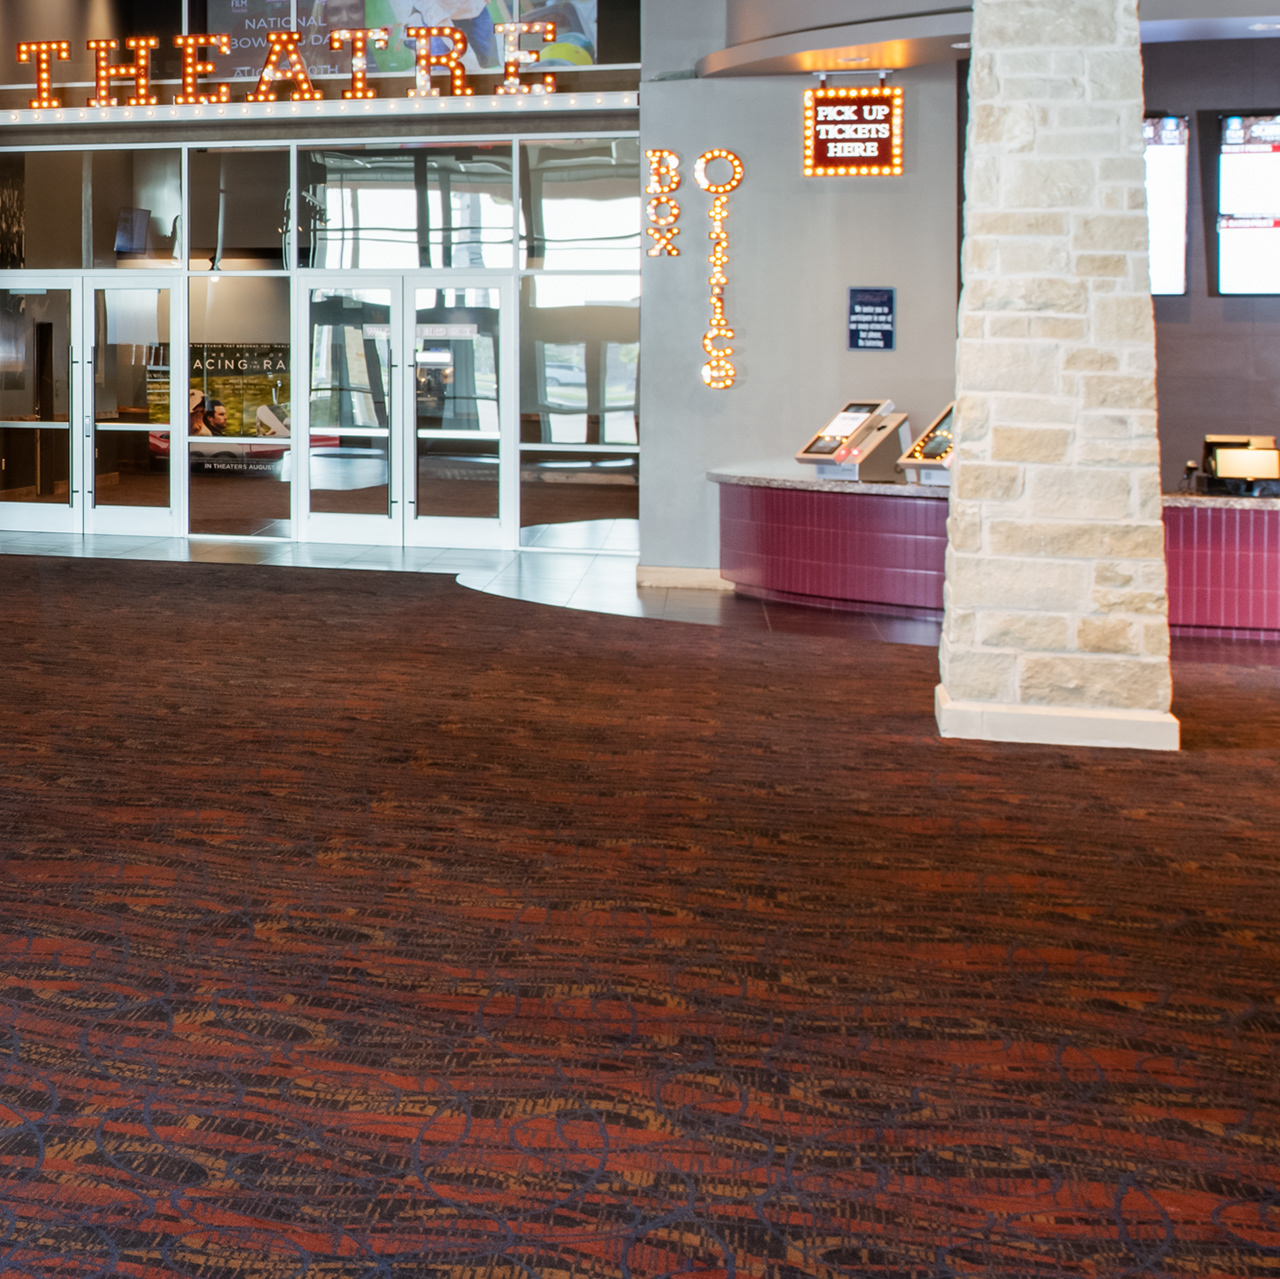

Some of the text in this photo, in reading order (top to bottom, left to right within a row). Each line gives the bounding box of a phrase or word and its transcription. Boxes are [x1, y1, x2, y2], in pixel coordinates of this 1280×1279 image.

[231, 0, 247, 8] FILM
[17, 21, 557, 109] THEATRE
[816, 105, 889, 121] PICK UP
[816, 123, 889, 139] TICKETS
[827, 142, 878, 157] HERE
[645, 149, 681, 256] BOX
[193, 359, 248, 370] ACING
